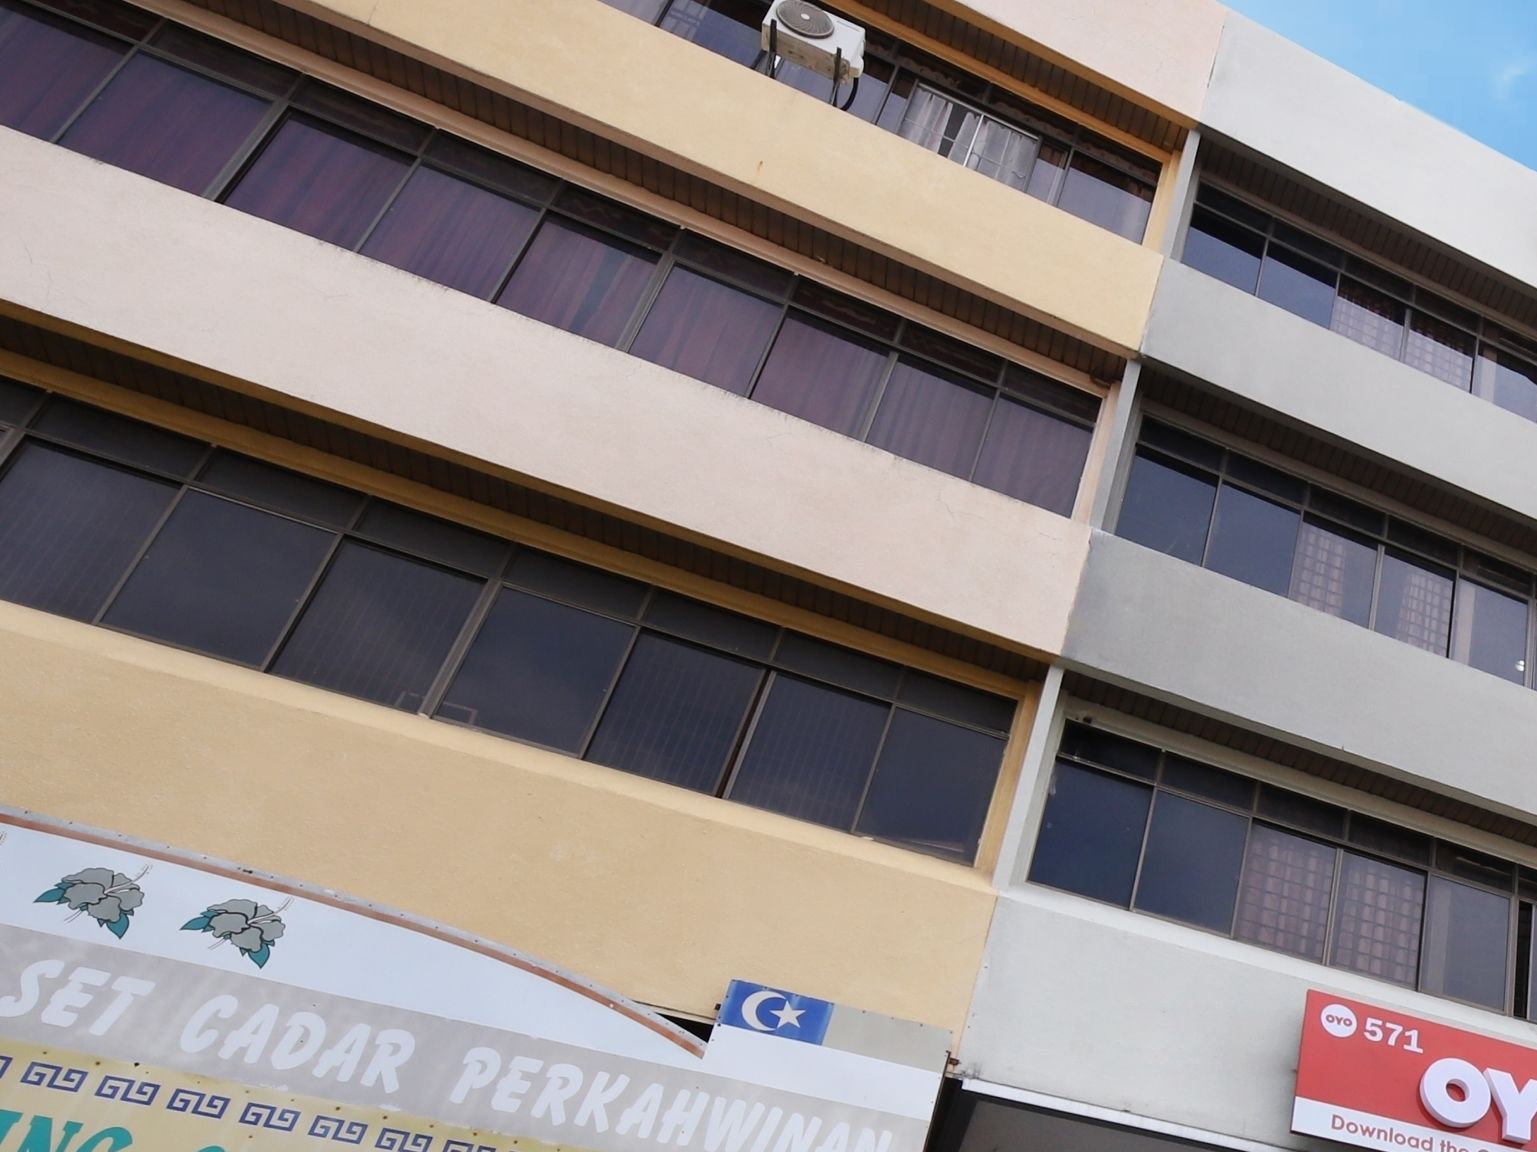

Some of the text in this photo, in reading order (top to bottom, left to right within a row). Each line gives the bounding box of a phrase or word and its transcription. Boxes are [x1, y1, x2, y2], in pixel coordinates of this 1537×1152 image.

[0, 959, 156, 1037] SET
[179, 995, 416, 1094] CADAR
[1325, 1014, 1424, 1054] OYO 571
[1331, 1114, 1433, 1152] Download
